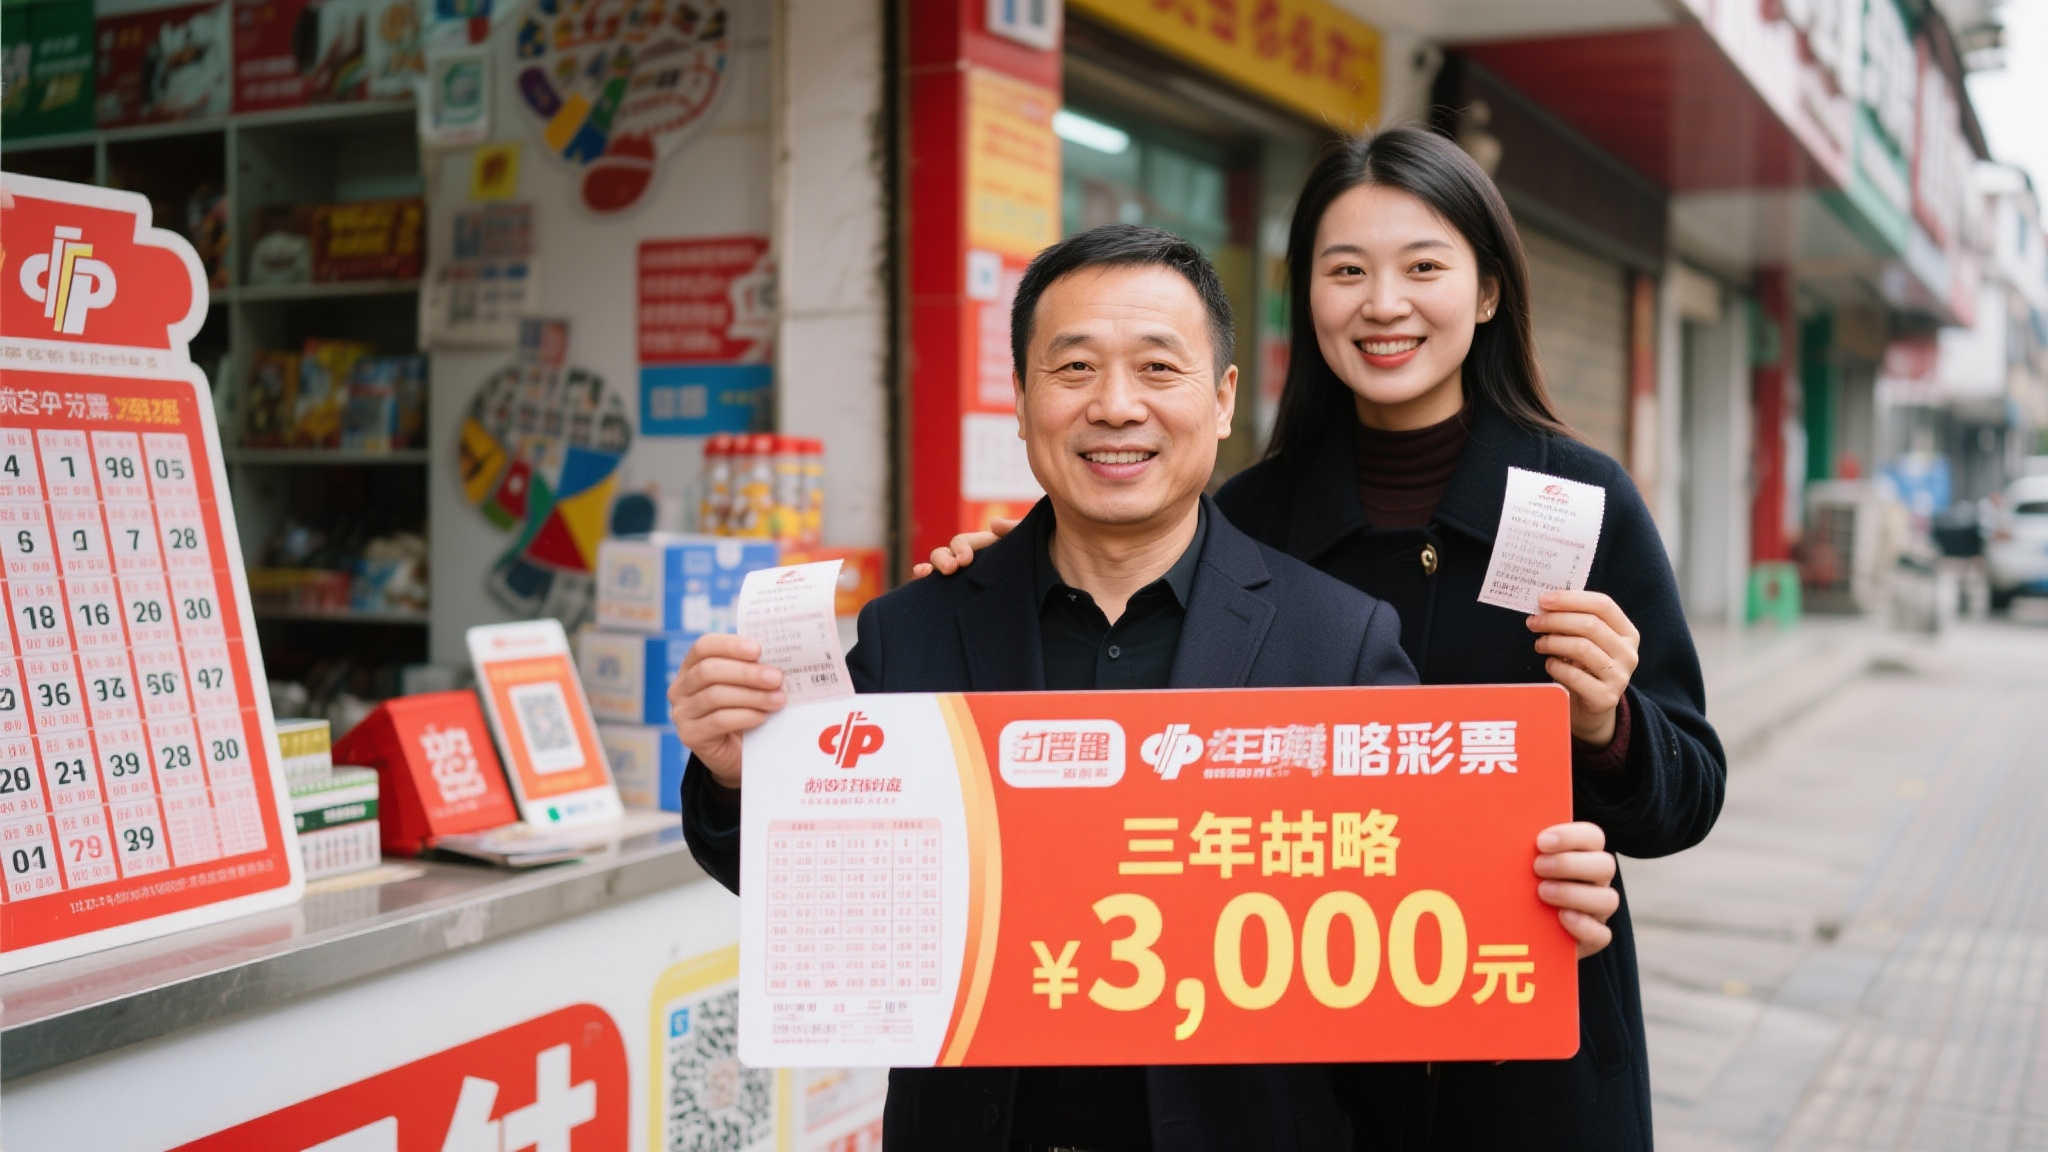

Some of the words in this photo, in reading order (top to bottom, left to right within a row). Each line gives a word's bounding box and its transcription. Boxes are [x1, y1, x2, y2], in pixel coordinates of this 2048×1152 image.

[4, 454, 20, 477] 4
[105, 457, 134, 479] 98
[17, 530, 34, 553] 6
[126, 529, 140, 550] 7
[169, 527, 197, 549] 28
[23, 605, 55, 629] 18
[80, 603, 110, 626] 16
[184, 598, 211, 620] 30
[38, 682, 71, 707] 36
[110, 752, 140, 777] 39
[162, 744, 192, 769] 28
[212, 738, 239, 762] 30
[12, 846, 47, 873] 01
[123, 825, 154, 852] 39
